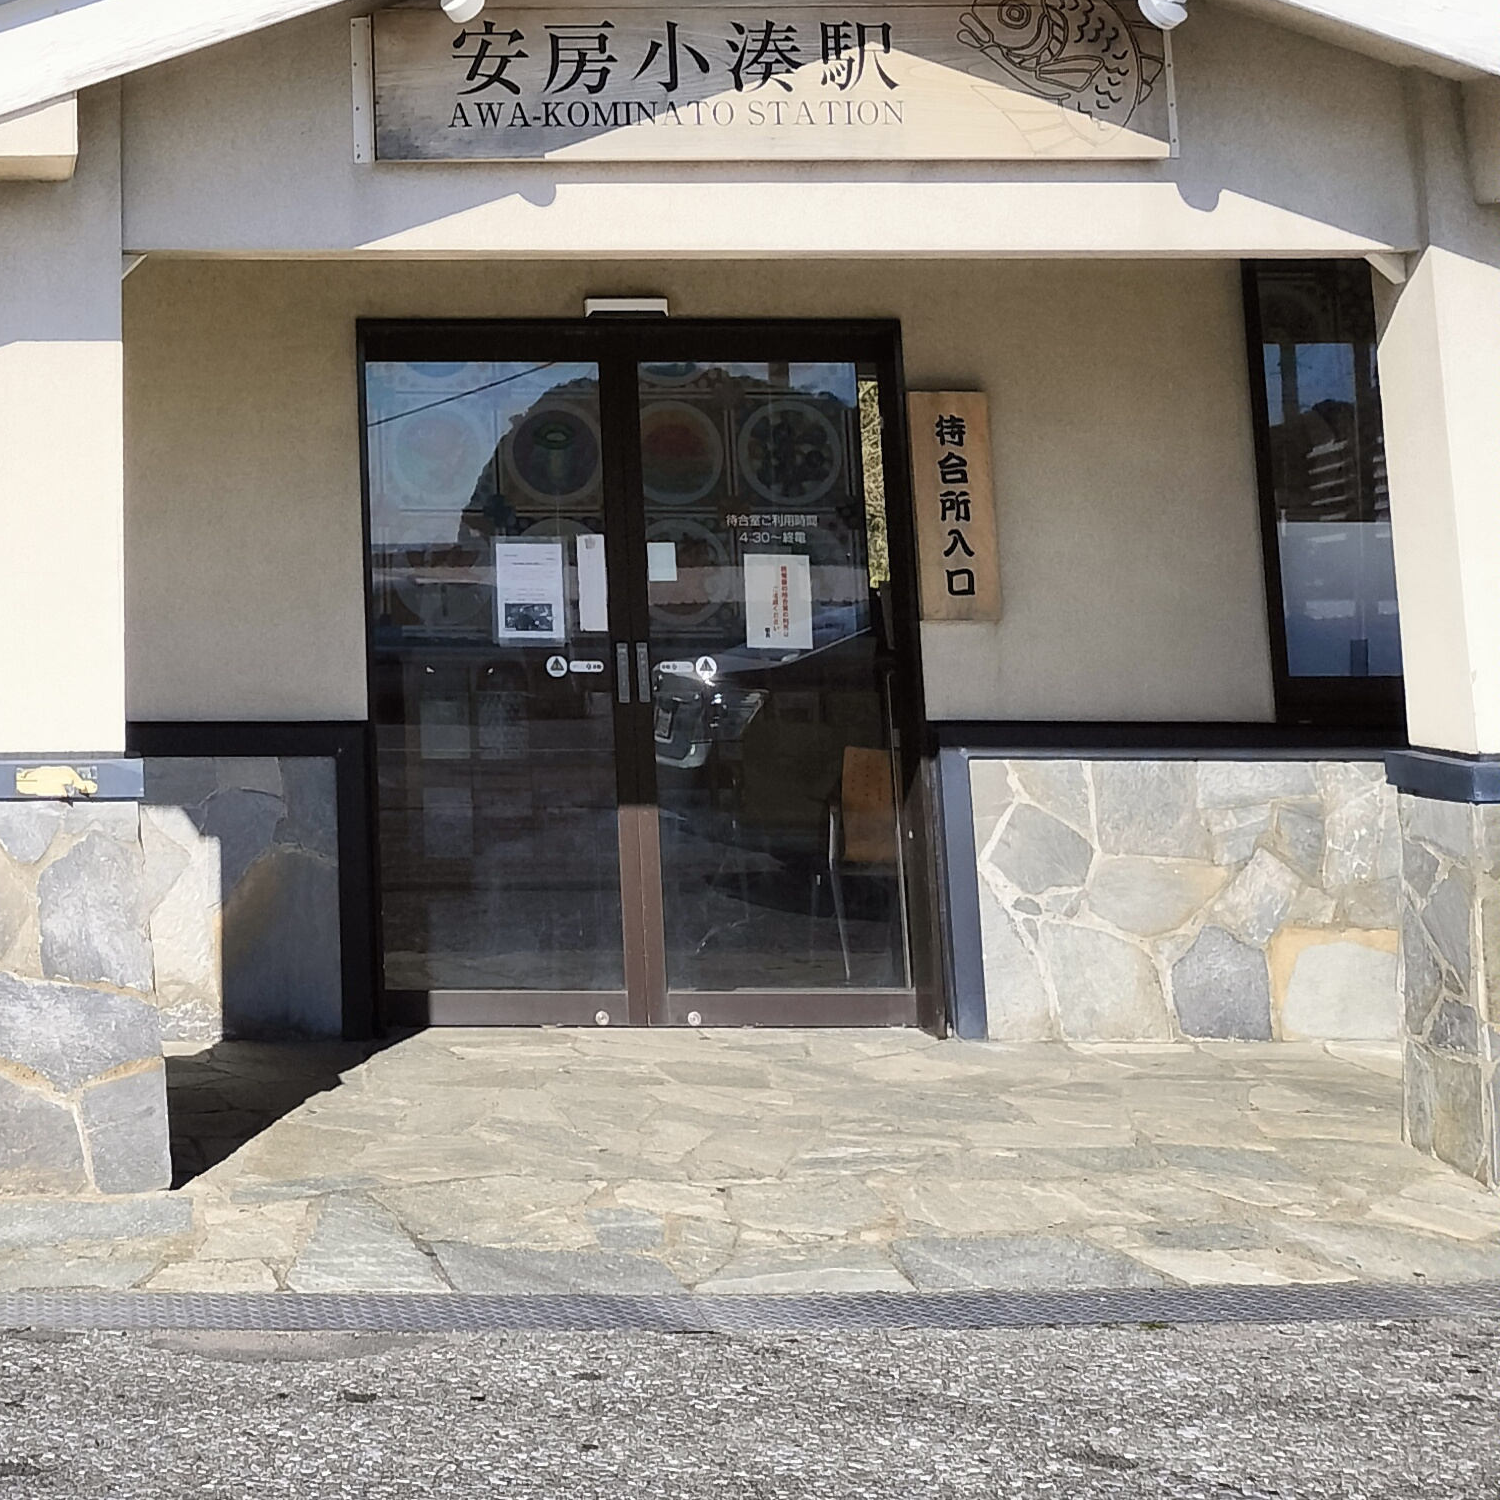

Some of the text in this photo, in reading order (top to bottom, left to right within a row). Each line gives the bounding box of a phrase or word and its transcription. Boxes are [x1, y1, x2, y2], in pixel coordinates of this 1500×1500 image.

[452, 19, 900, 95] 安房小湊駅
[448, 100, 904, 128] AWA-KOMINATO STATION
[935, 414, 976, 596] 待合所入口
